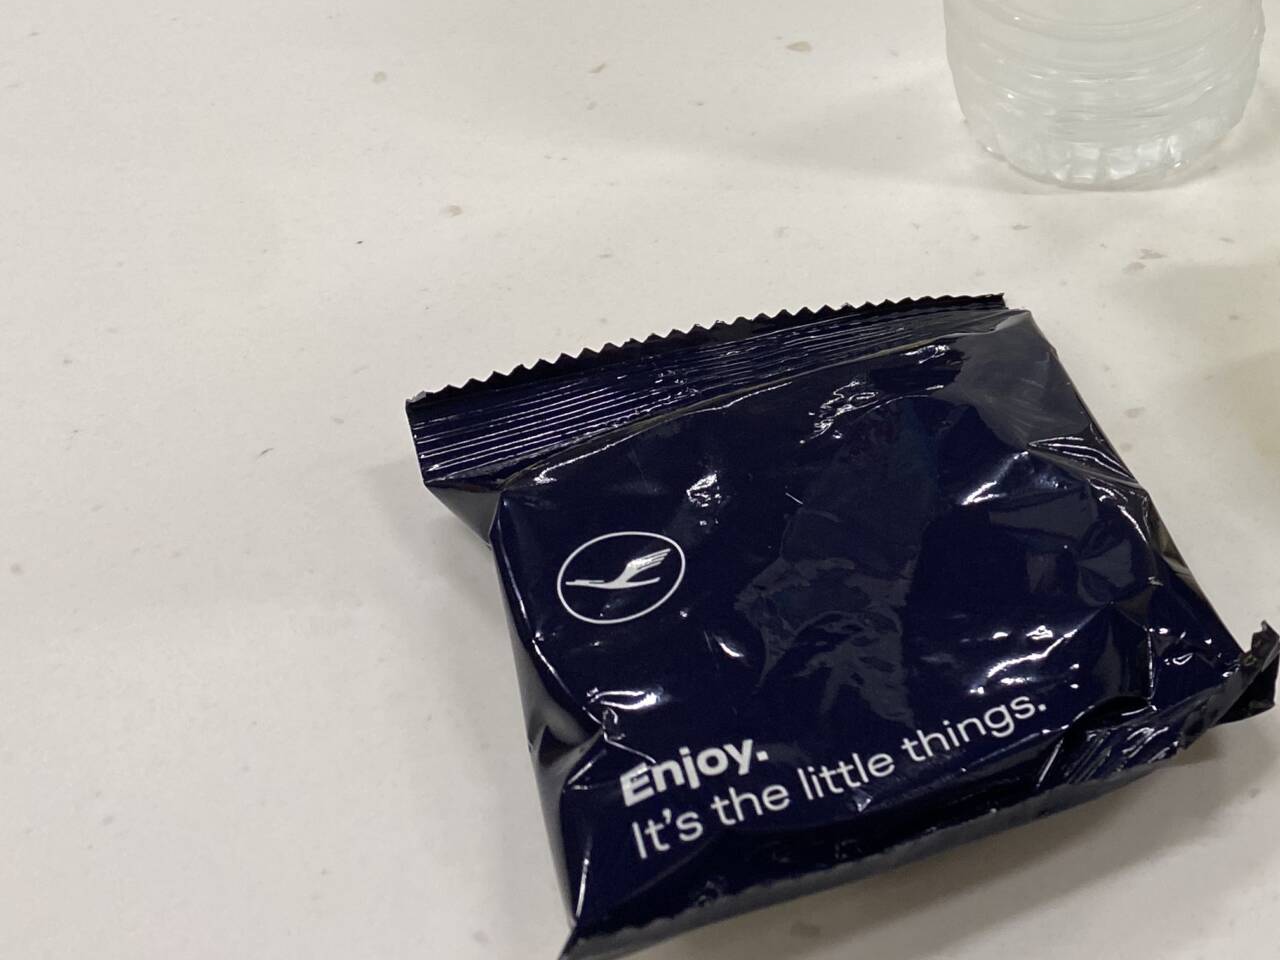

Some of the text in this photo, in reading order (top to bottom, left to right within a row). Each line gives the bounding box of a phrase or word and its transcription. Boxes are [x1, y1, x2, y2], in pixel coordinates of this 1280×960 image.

[620, 737, 769, 807] Enjoy.
[711, 783, 791, 828] the
[797, 748, 895, 800] little
[902, 695, 1047, 764] things.
